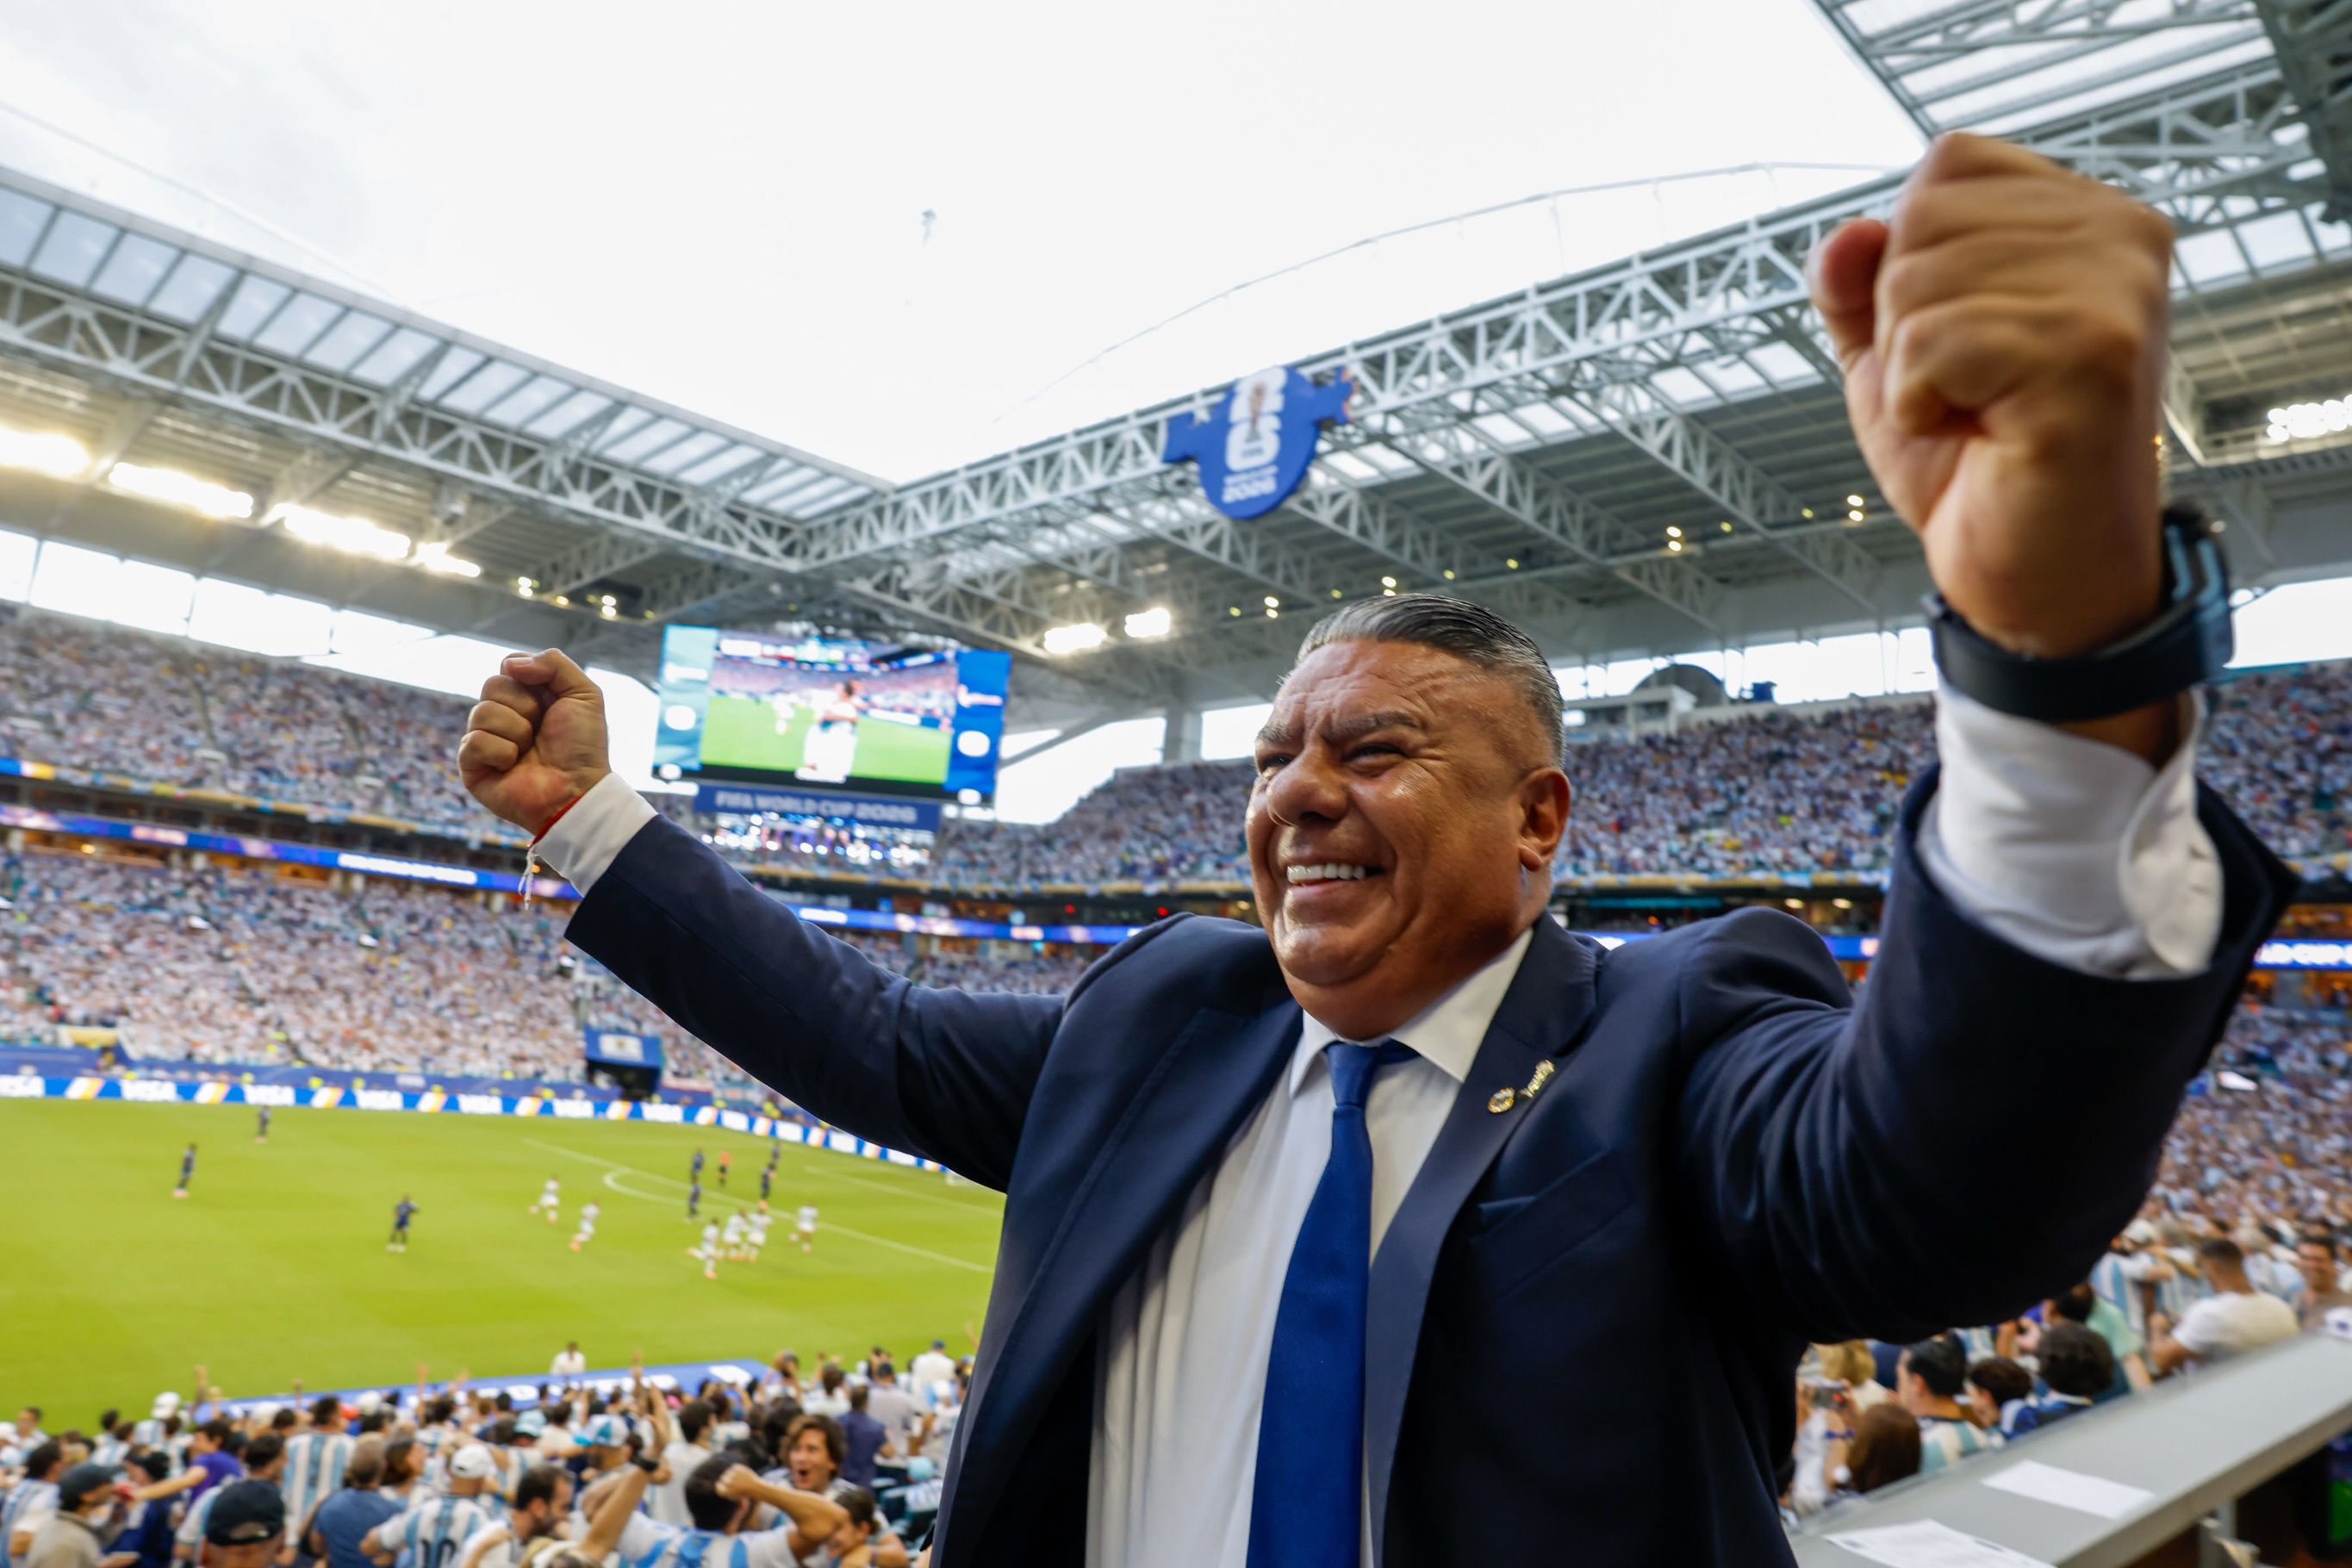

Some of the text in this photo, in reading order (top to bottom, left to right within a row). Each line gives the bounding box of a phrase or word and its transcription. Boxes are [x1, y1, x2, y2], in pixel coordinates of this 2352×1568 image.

[715, 791, 917, 824] FIFA WORLD CUP 2026
